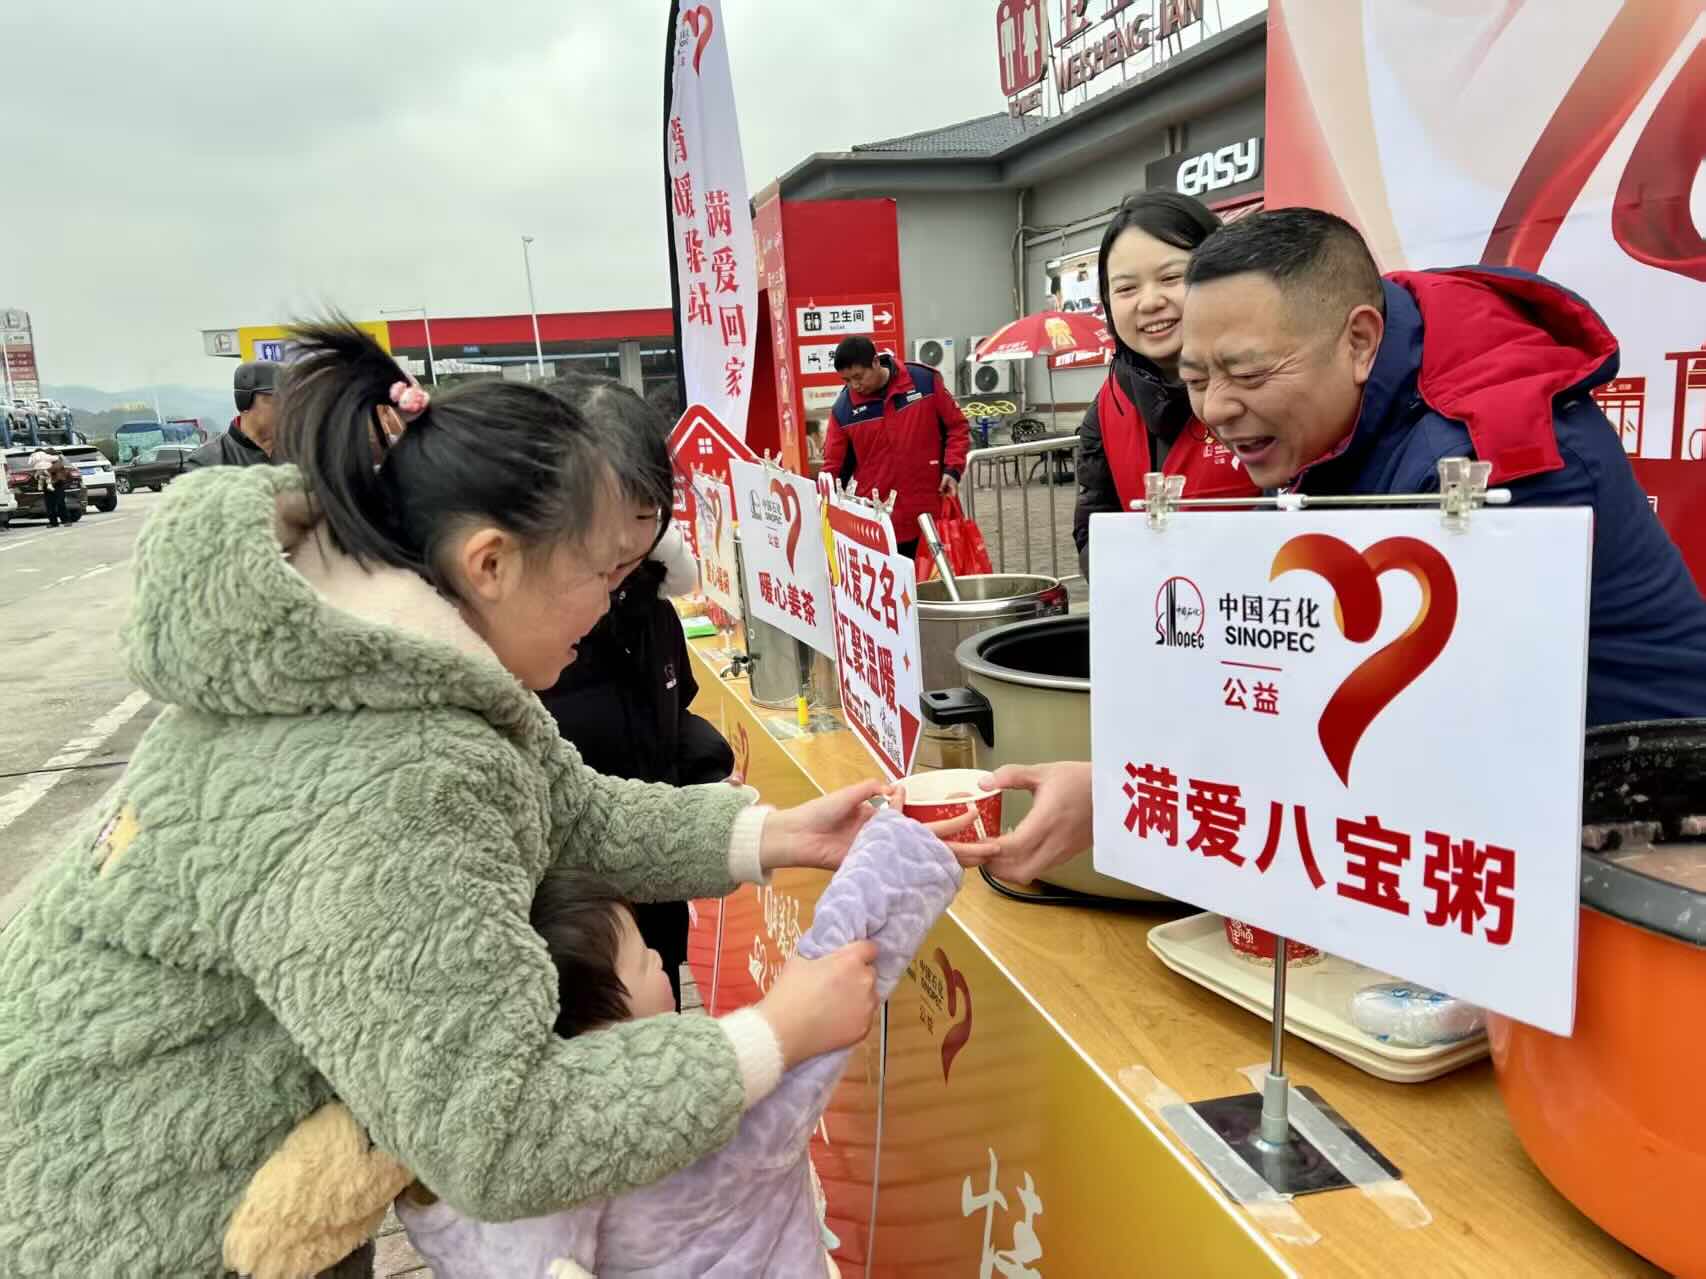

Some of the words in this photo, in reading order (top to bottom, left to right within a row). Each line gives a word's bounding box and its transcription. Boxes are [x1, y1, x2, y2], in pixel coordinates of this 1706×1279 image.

[1177, 137, 1260, 196] EASY
[704, 190, 748, 398] 满爱回家
[829, 309, 864, 323] 卫生间
[759, 572, 816, 627] 暖心姜茶
[837, 540, 901, 636] 以爱之名
[1219, 593, 1320, 628] 中国石化
[836, 612, 898, 712] 汇聚温暖
[1225, 626, 1315, 653] SINOPEC
[1223, 678, 1279, 715] 公益
[1121, 761, 1517, 946] 满爱八宝粥
